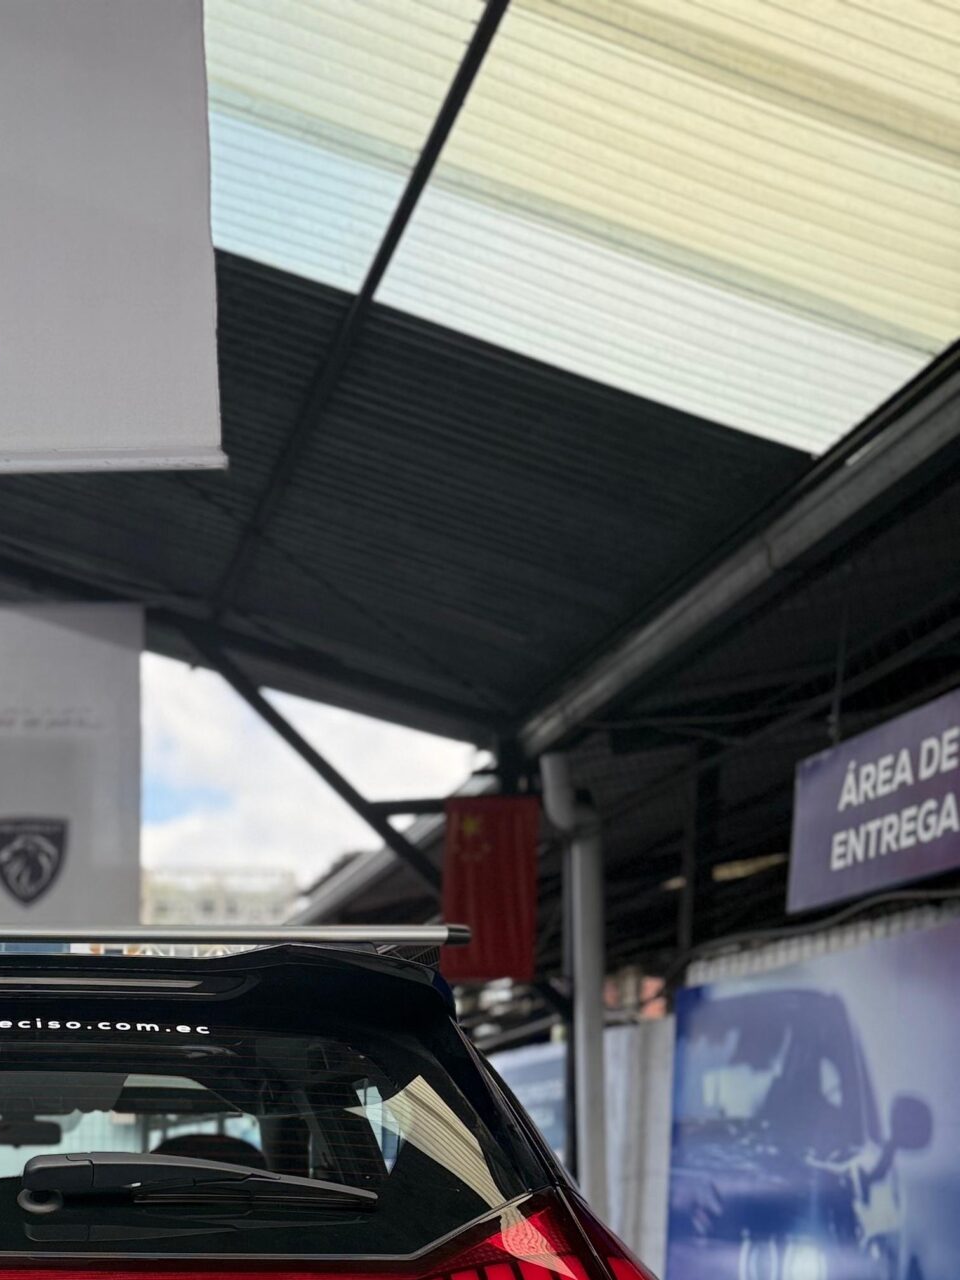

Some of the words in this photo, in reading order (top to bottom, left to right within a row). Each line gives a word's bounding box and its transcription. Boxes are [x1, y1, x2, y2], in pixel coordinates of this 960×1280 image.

[837, 748, 914, 812] ÁREA
[918, 726, 960, 781] DE
[830, 792, 960, 871] ENTREGA
